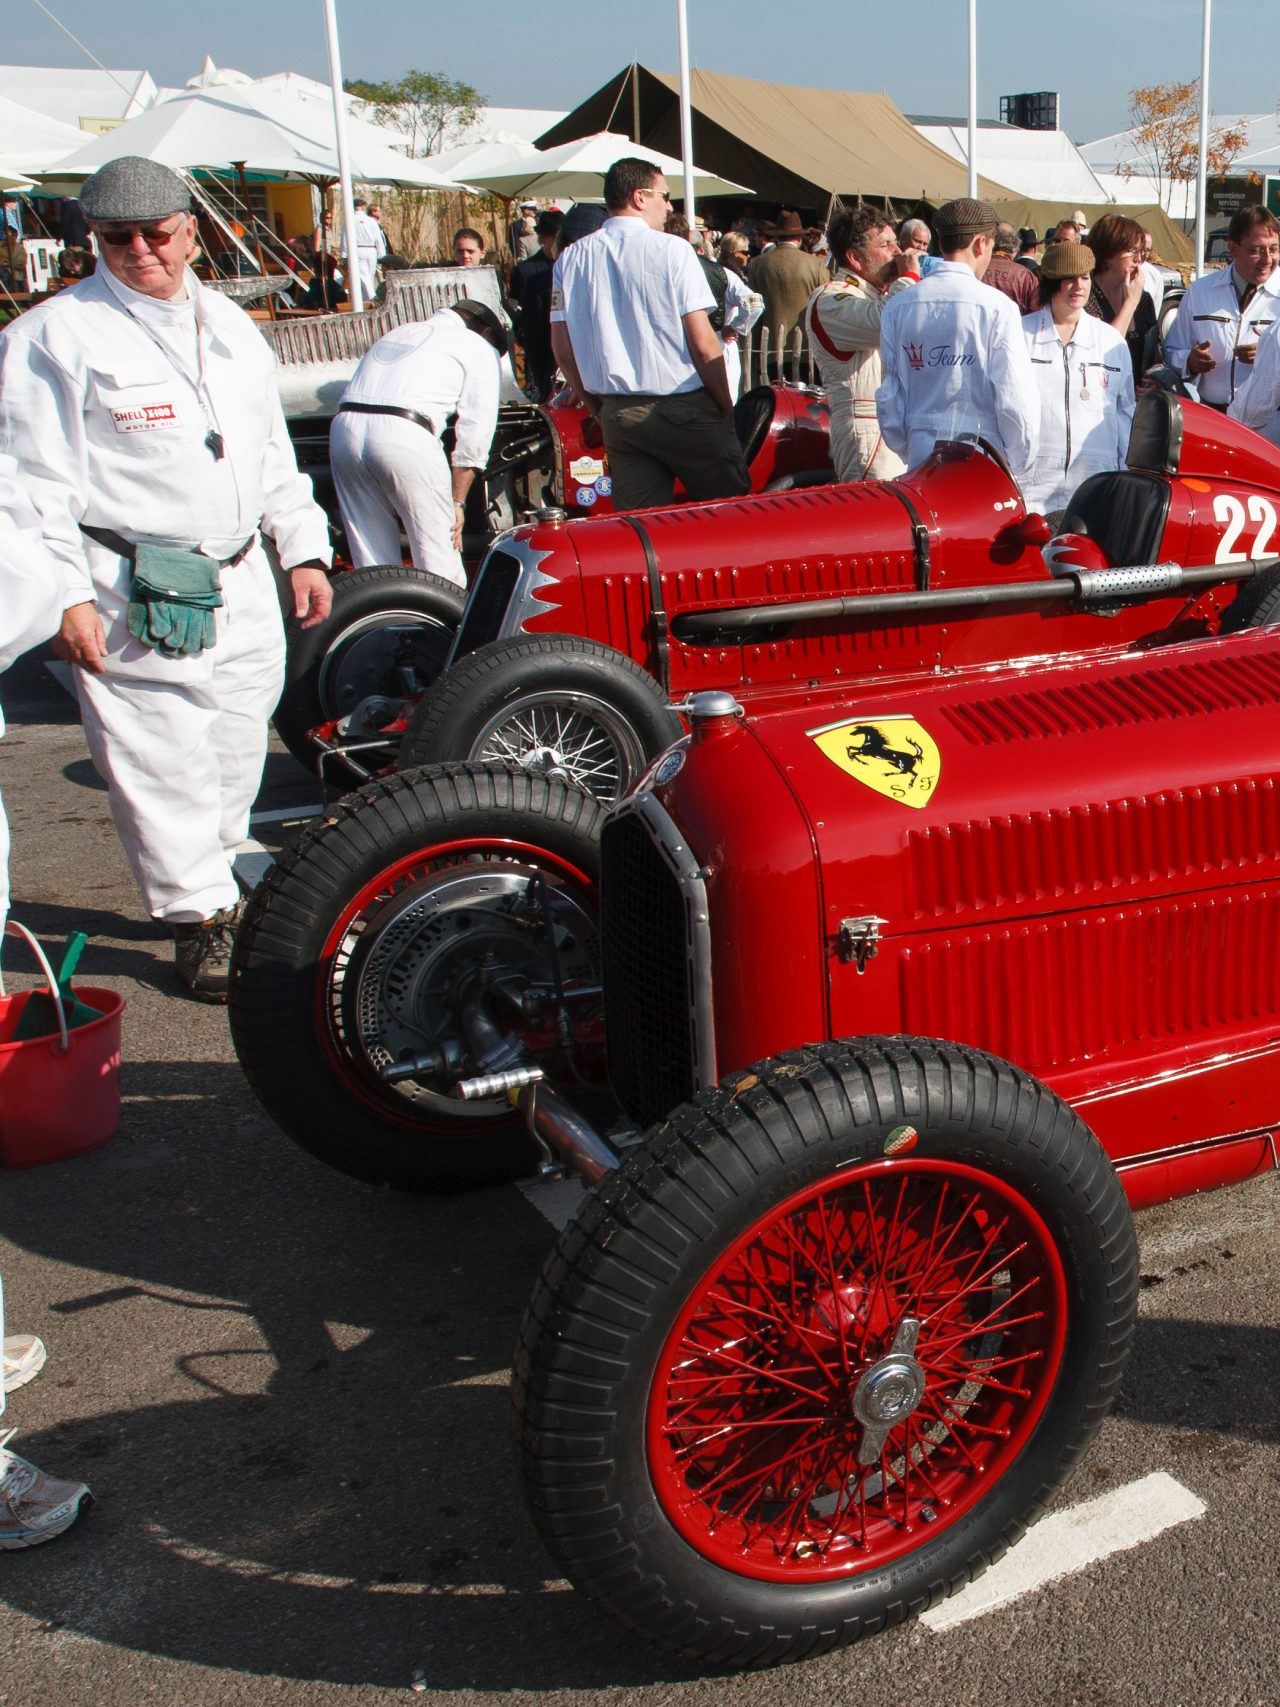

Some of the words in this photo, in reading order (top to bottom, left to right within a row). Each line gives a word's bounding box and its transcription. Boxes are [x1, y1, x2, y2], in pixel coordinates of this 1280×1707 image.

[927, 345, 977, 367] Team
[114, 411, 145, 422] SHELL
[125, 423, 157, 431] MOTOR
[1213, 494, 1279, 565] 22
[890, 784, 906, 798] S
